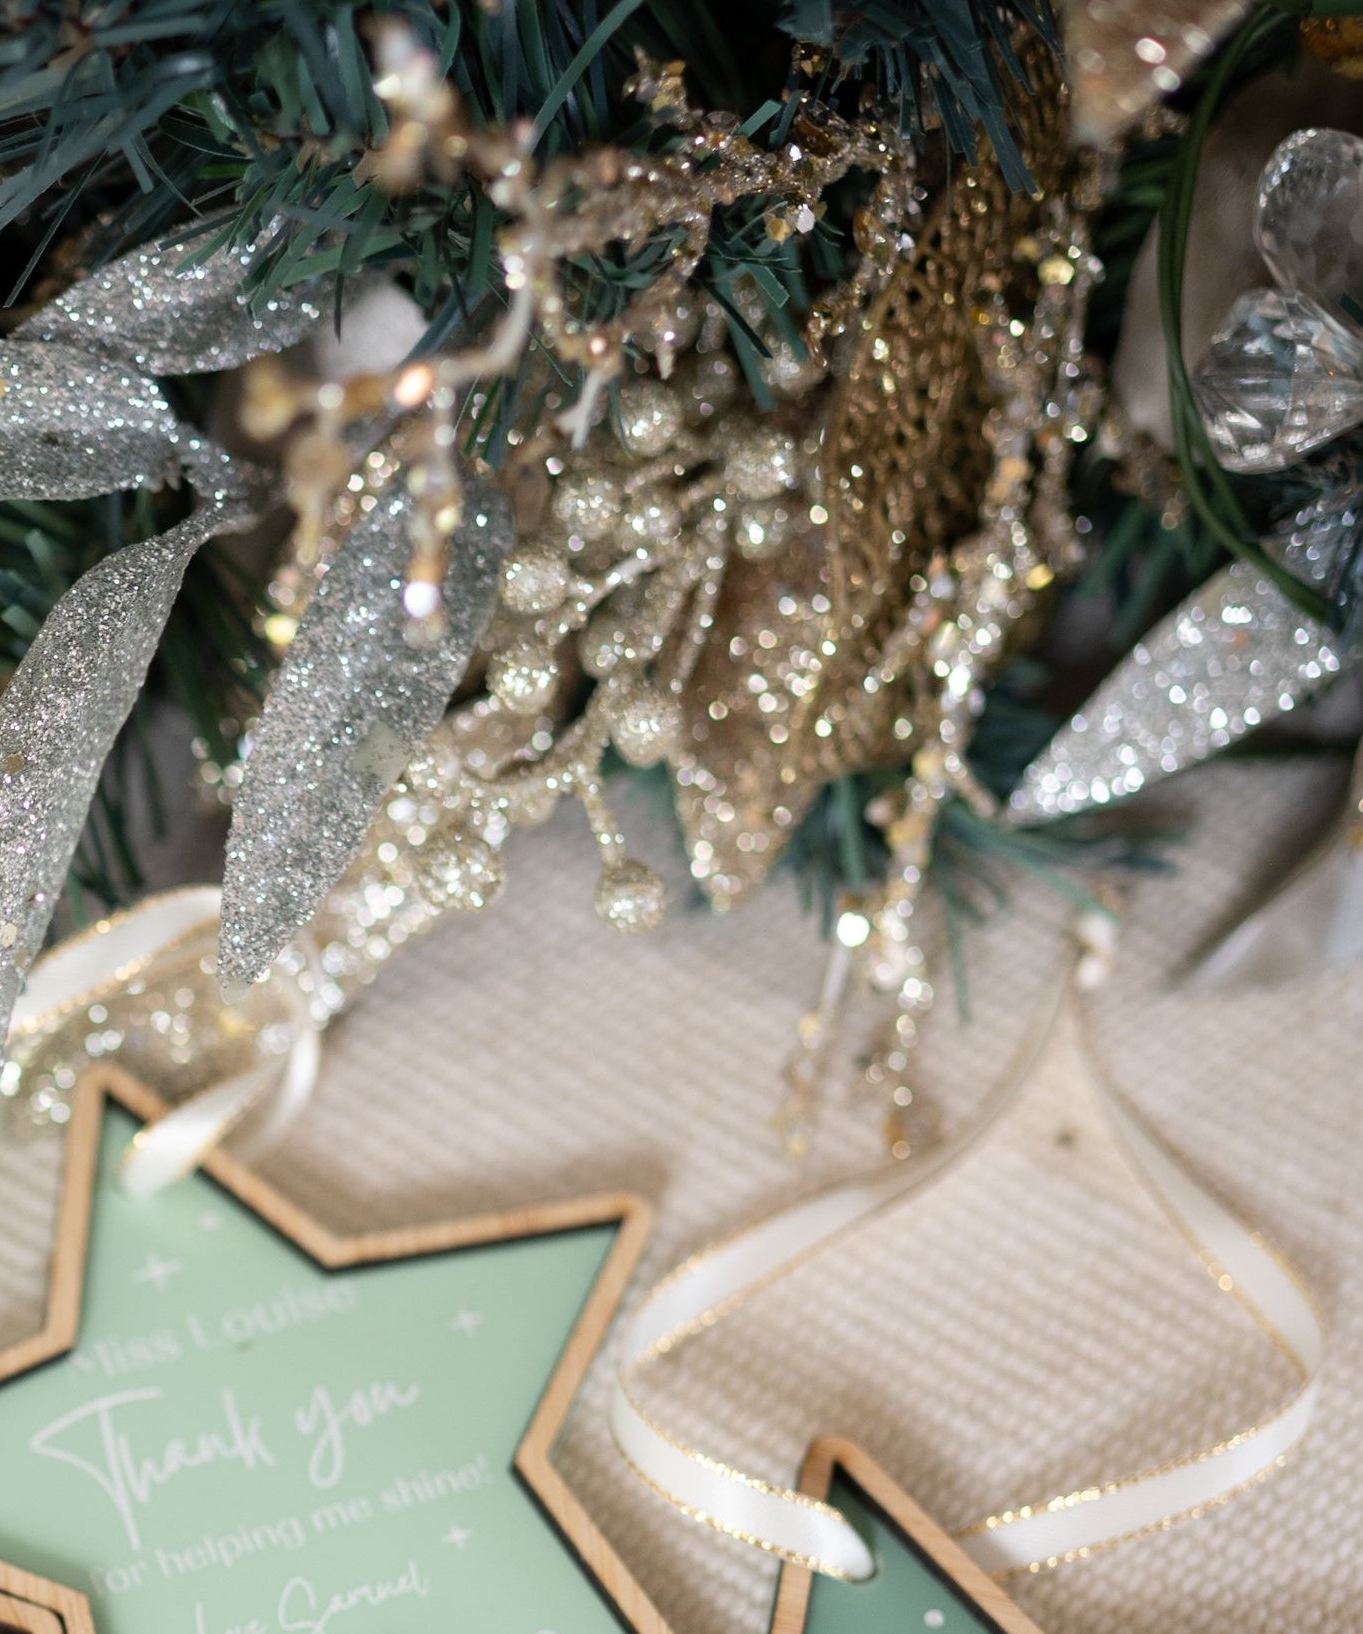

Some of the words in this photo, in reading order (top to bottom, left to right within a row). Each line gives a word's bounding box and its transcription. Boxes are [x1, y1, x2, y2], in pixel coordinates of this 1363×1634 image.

[187, 1279, 358, 1348] Louise
[30, 1386, 275, 1551] Thank
[295, 1382, 420, 1488] you
[90, 1560, 148, 1600] for
[155, 1518, 305, 1577] helping
[311, 1496, 372, 1532] me
[380, 1454, 491, 1512] shine!
